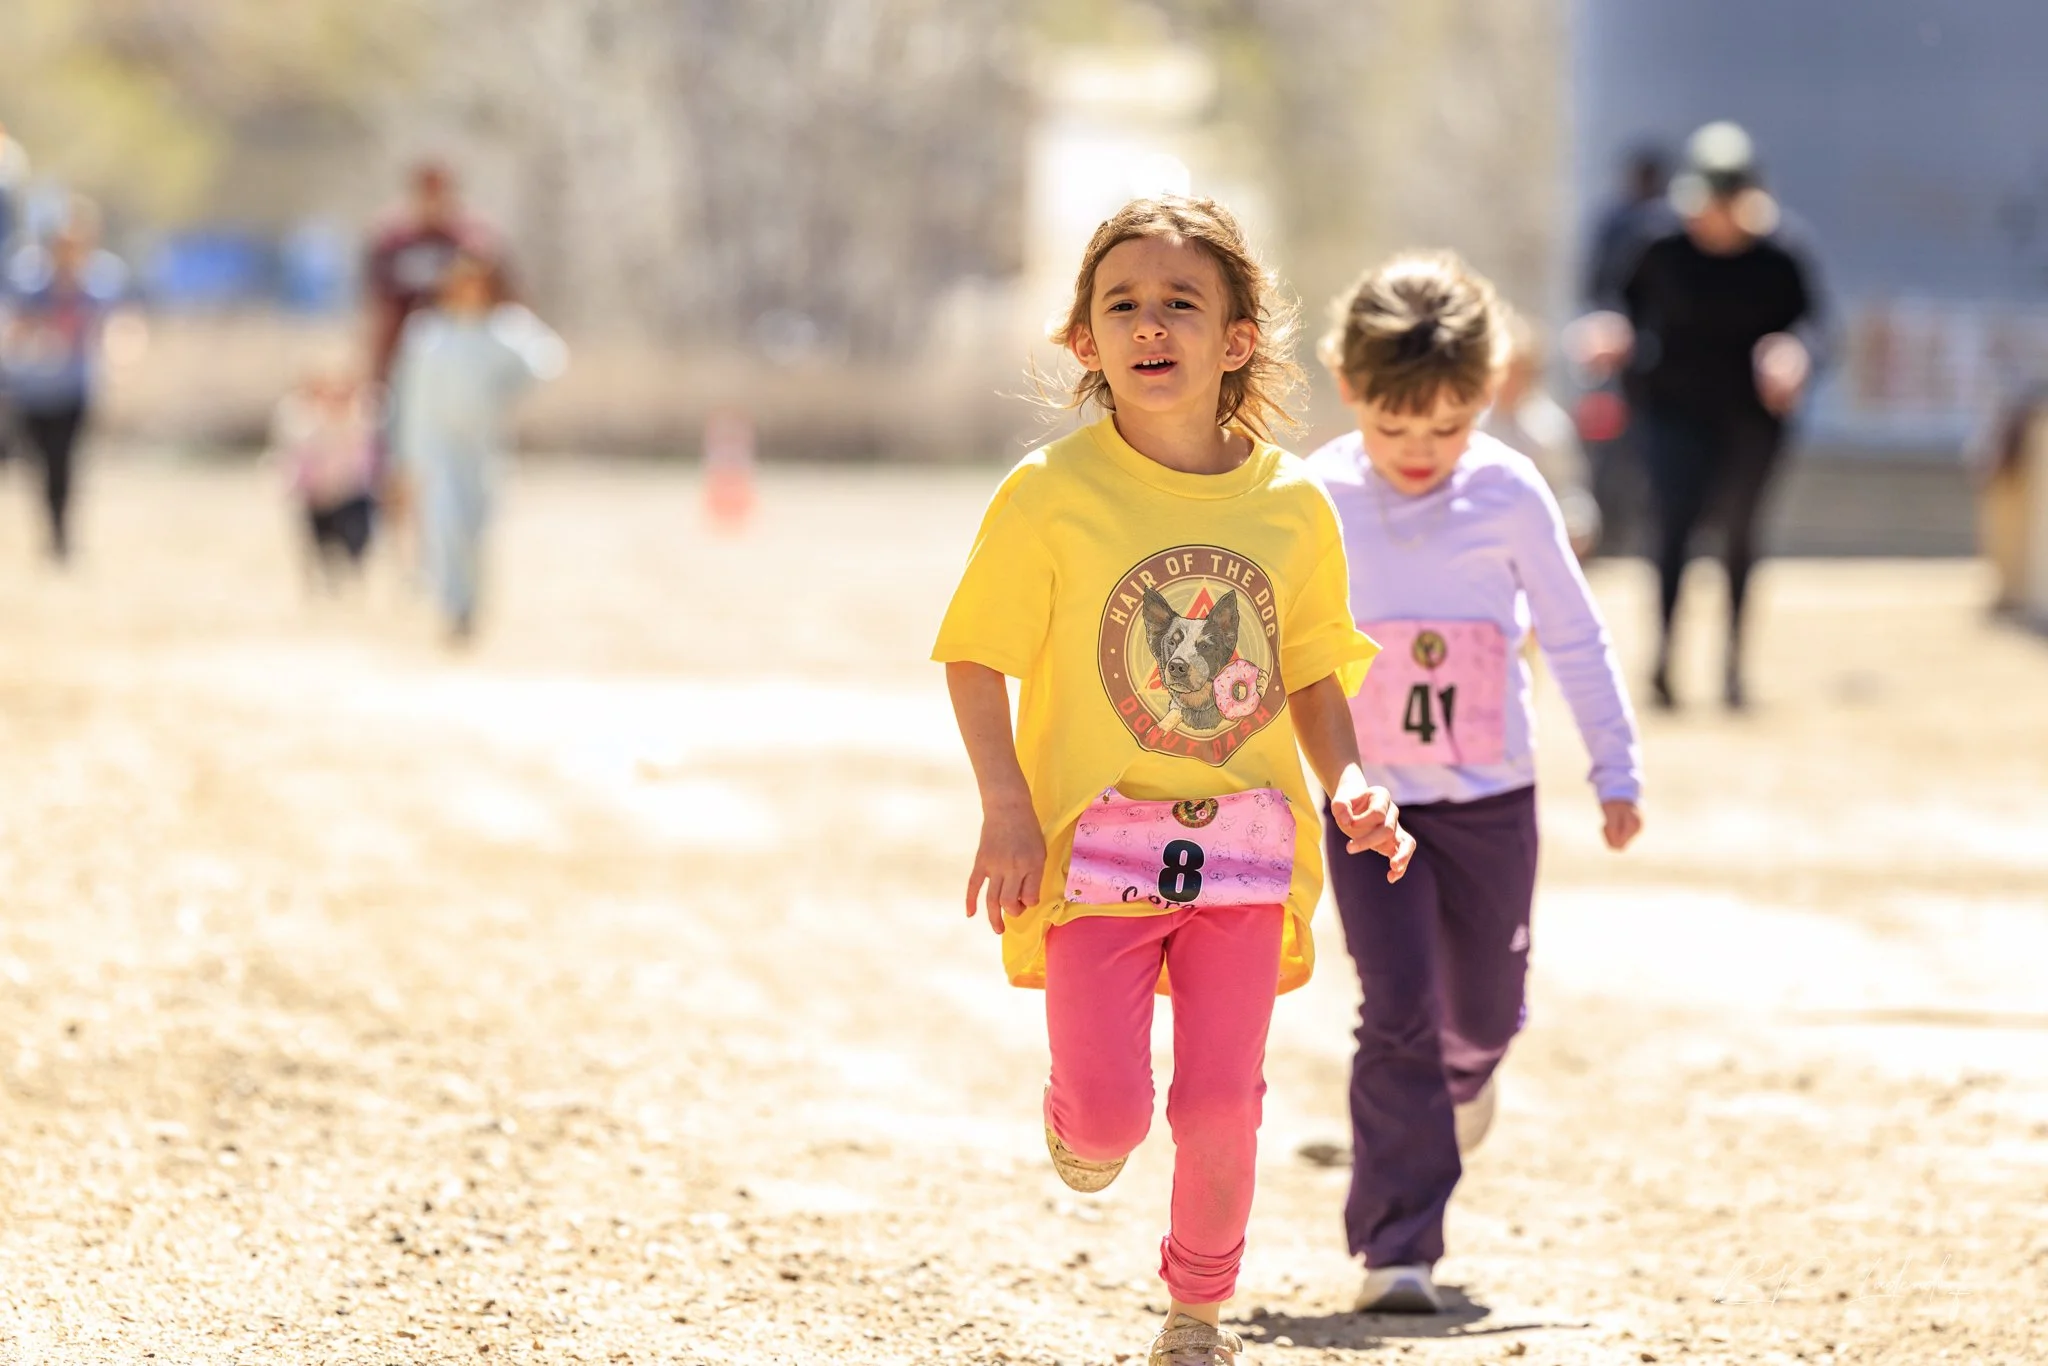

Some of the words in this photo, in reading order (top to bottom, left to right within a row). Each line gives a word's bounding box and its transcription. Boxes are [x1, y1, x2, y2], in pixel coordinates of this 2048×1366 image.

[1109, 569, 1158, 626] HAIR
[1165, 553, 1194, 576] OF
[1210, 554, 1256, 588] THE
[1254, 587, 1276, 638] DOG
[1118, 694, 1199, 755] DONUT
[1212, 704, 1272, 761] DASH
[1158, 839, 1205, 903] 8
